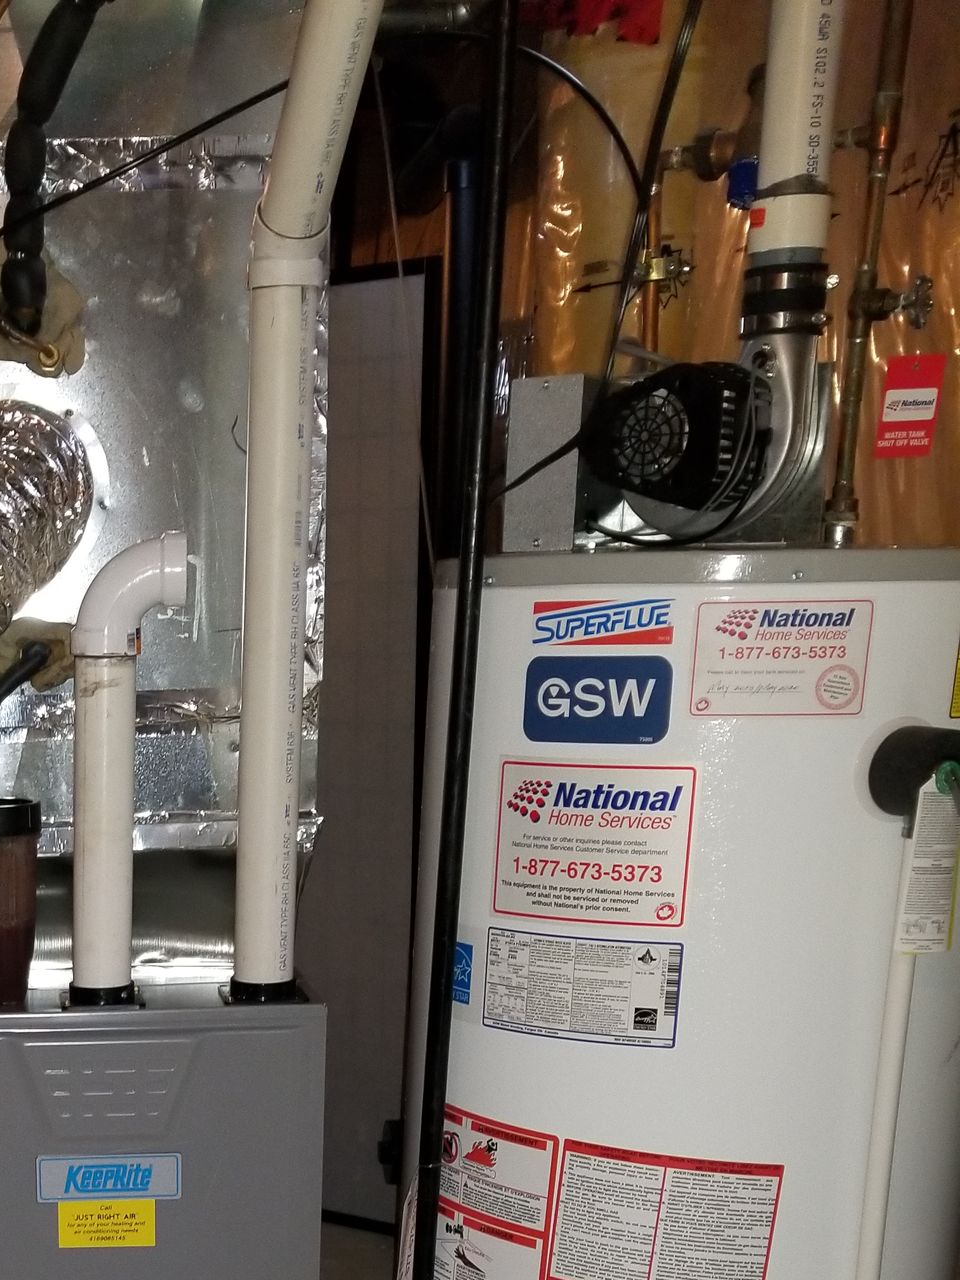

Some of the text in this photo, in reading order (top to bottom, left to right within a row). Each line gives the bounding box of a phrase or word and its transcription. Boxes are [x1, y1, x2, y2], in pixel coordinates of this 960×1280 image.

[901, 398, 935, 408] National
[884, 431, 907, 439] WATER
[877, 440, 894, 448] SHUT
[909, 438, 930, 446] VALVE
[759, 608, 856, 628] National
[755, 628, 848, 641] Home Services
[719, 645, 847, 660] 1-877-673-5373
[538, 677, 656, 718] GSW
[553, 782, 683, 812] National
[548, 809, 672, 830] Home Services
[512, 840, 668, 856] National Home Services Customer Service department
[575, 837, 601, 845] inquiries
[513, 856, 663, 884] 1-877-673-5373
[501, 879, 512, 887] This
[513, 881, 541, 890] equipment
[559, 885, 585, 894] property
[595, 887, 622, 896] National
[623, 889, 643, 897] Home
[645, 890, 675, 898] Services
[537, 891, 552, 899] shall
[563, 893, 571, 901] be
[572, 895, 600, 903] serviced
[609, 897, 639, 905] removed
[531, 899, 631, 913] without National's prior consent.
[97, 1213, 120, 1221] RIGHT
